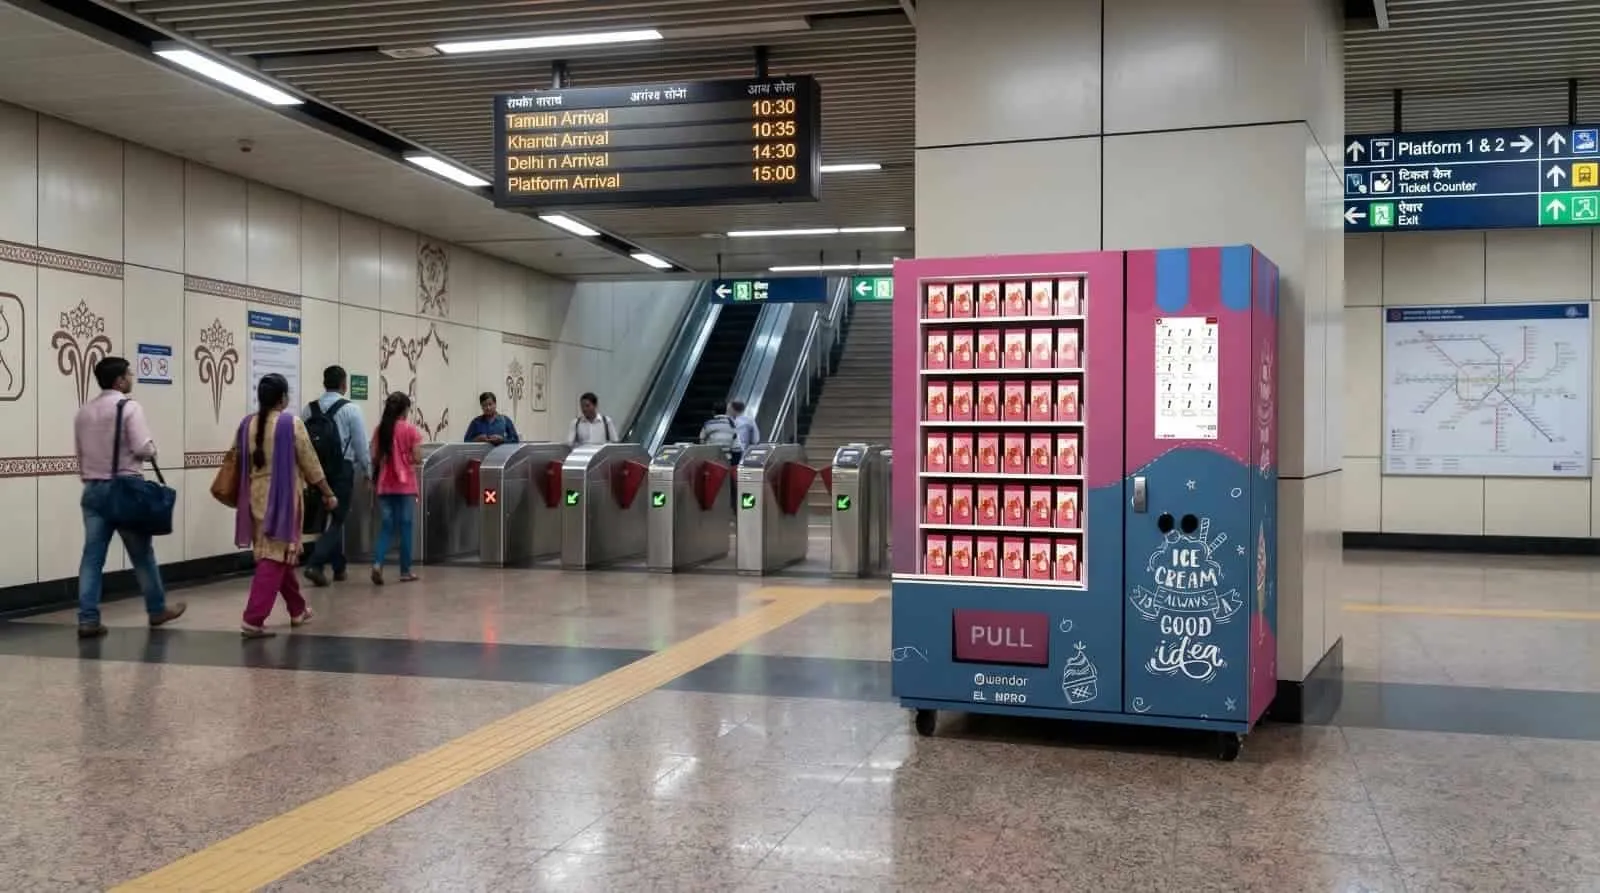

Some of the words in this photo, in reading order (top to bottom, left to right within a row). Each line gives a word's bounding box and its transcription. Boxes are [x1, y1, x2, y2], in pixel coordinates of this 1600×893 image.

[752, 99, 796, 116] 10:30
[561, 109, 609, 126] Arrival
[752, 121, 796, 138] 10:35
[561, 131, 609, 148] Arrival
[1398, 140, 1461, 156] Platform
[1466, 138, 1473, 153] 1
[1479, 137, 1491, 153] &
[1494, 137, 1505, 152] 2
[752, 143, 796, 160] 14:30
[508, 154, 544, 171] Delhi
[548, 157, 557, 169] n
[561, 152, 609, 168] Arrival
[752, 165, 796, 181] 15:00
[508, 176, 568, 193] Platform
[572, 173, 620, 189] Arrival
[1399, 181, 1431, 193] Ticket
[1433, 181, 1477, 193] Counter
[1398, 214, 1419, 225] Exit
[1172, 549, 1201, 568] ICE
[1154, 565, 1219, 589] CREAM
[1160, 615, 1212, 636] GOOD
[970, 625, 1034, 648] PULL
[1150, 635, 1225, 679] idea
[985, 674, 1029, 687] wendor
